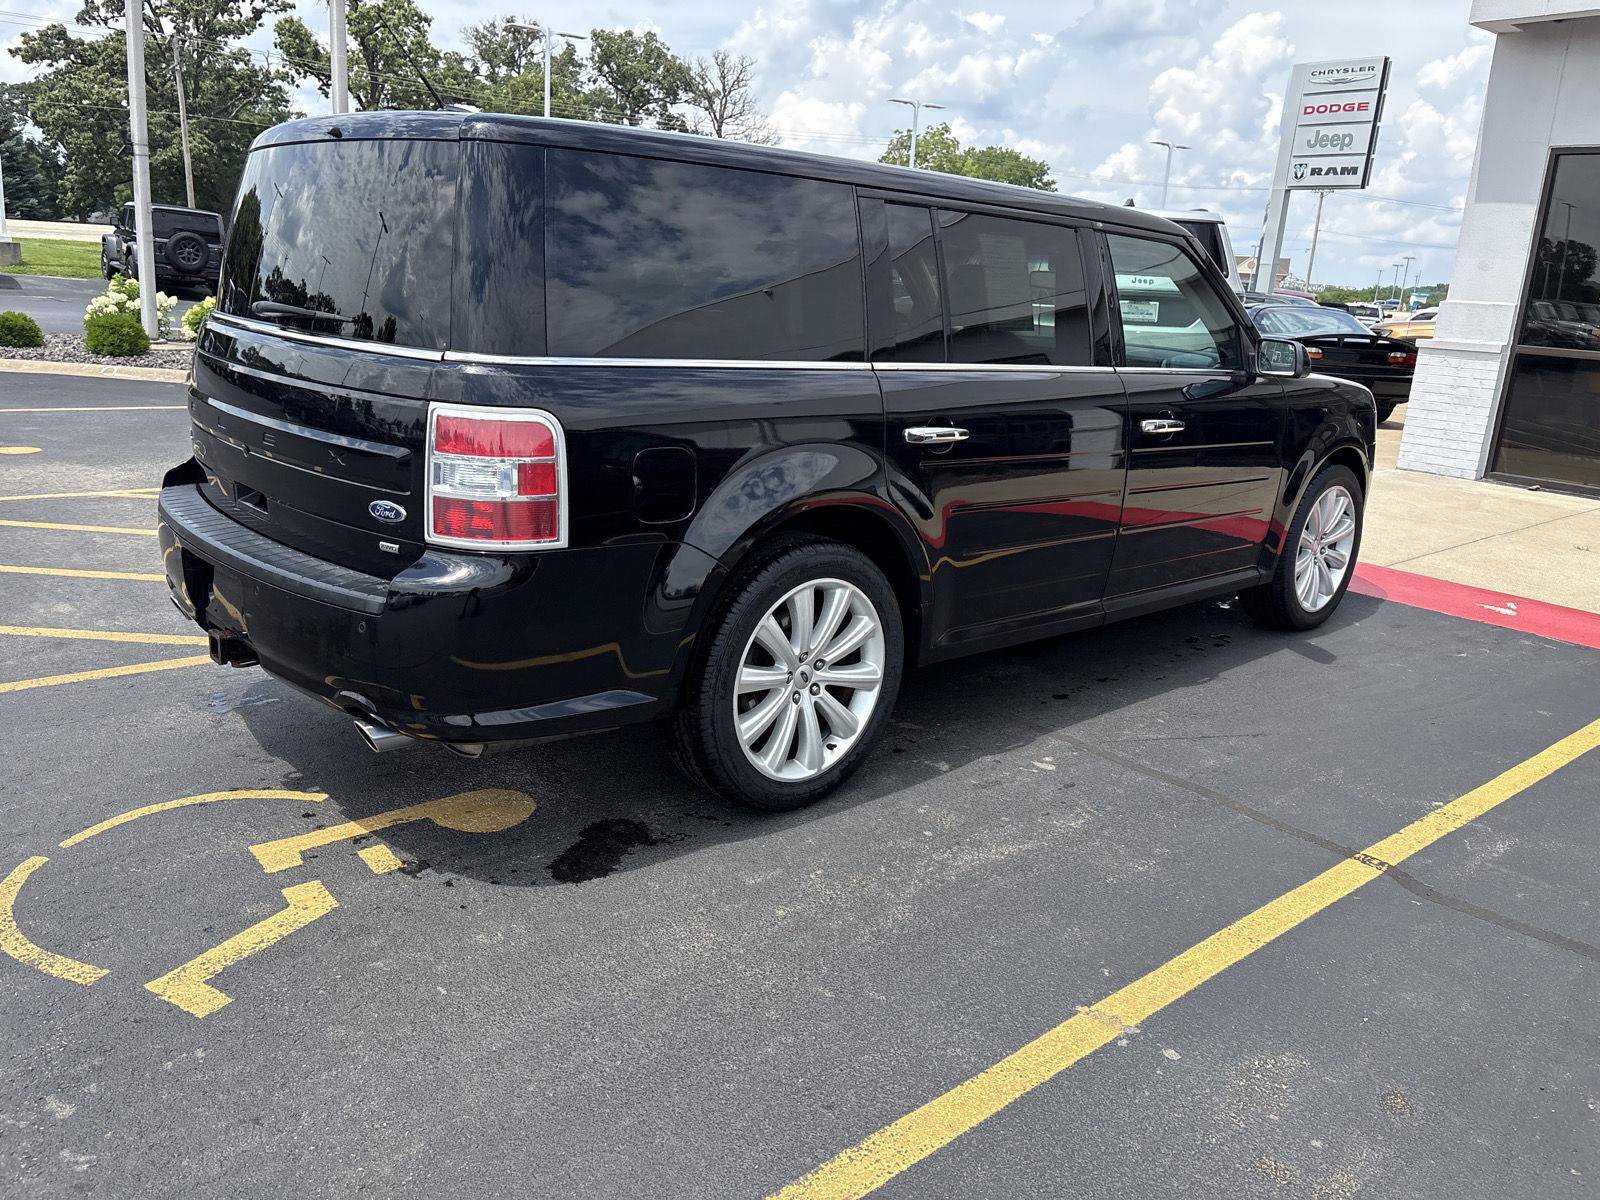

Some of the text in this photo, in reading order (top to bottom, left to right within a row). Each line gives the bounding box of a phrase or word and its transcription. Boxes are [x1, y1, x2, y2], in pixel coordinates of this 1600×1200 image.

[1311, 65, 1376, 77] CHRYSLER
[1303, 102, 1370, 115] DODGE
[1306, 130, 1354, 151] Jeep
[1309, 166, 1359, 176] RAM
[1131, 277, 1154, 285] Jeep
